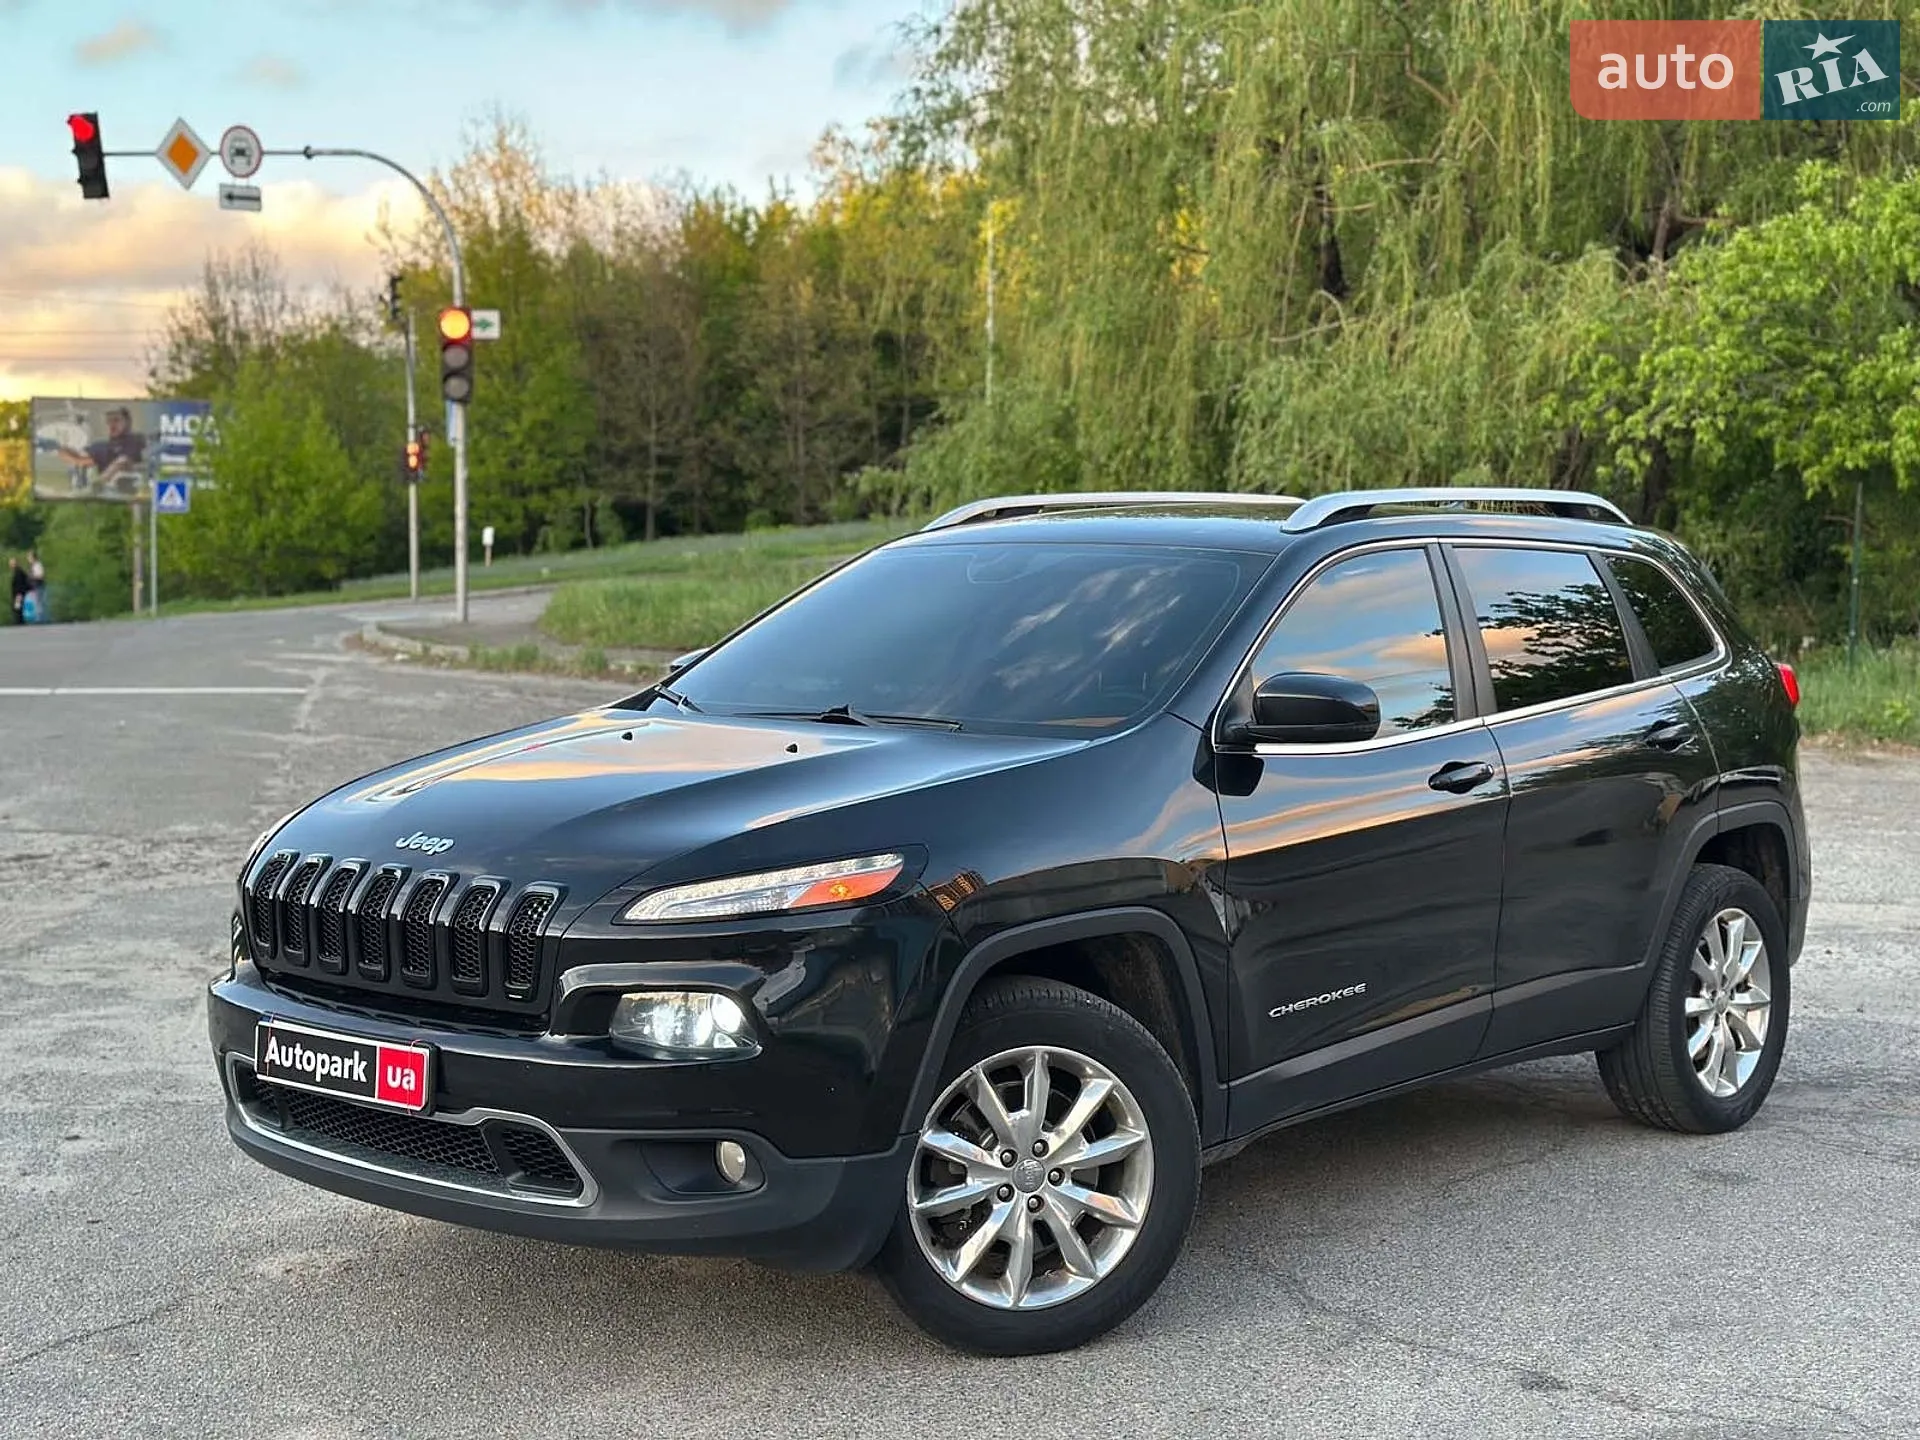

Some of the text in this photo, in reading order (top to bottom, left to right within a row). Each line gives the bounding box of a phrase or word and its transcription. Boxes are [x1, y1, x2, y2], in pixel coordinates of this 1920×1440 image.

[395, 831, 454, 855] Jeep
[1268, 983, 1366, 1018] CHEROKEE
[264, 1036, 416, 1091] Autopark ua
